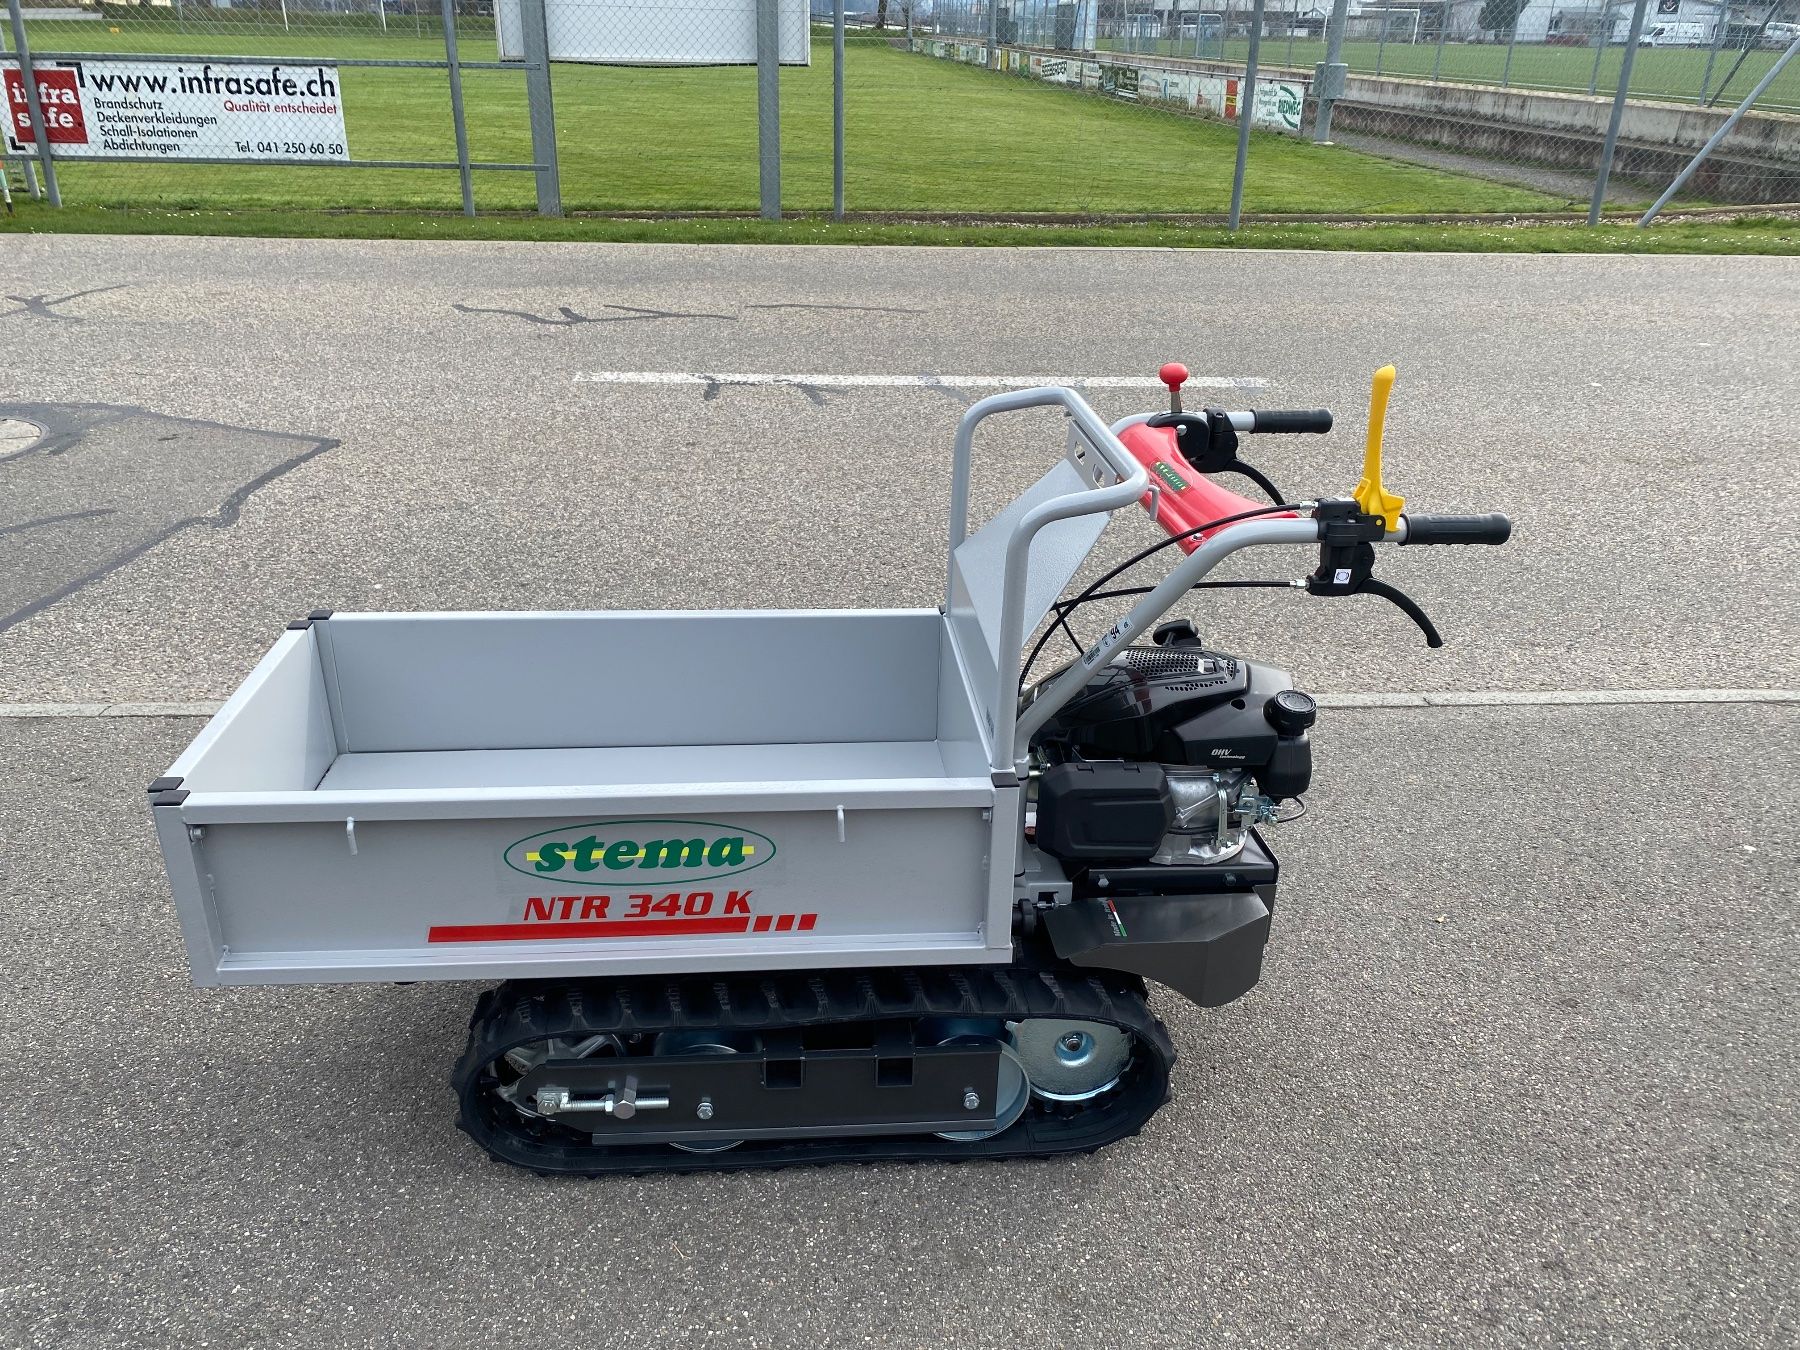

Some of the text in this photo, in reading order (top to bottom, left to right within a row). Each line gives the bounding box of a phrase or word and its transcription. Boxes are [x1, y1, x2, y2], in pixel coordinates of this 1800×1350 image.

[90, 65, 336, 97] www.infrasafe.ch
[93, 97, 163, 110] Brandschutz
[223, 100, 337, 114] Qualität entscheidet
[17, 107, 74, 128] sfe
[97, 111, 217, 128] Deckenverkleidungen
[100, 125, 198, 138] Schall-Isolationen
[104, 138, 180, 154] Abdichtungen
[235, 141, 343, 155] Tel. 041 250 60 50
[1211, 748, 1232, 756] OHV
[534, 835, 745, 872] stema
[523, 890, 755, 921] NTR 340 K
